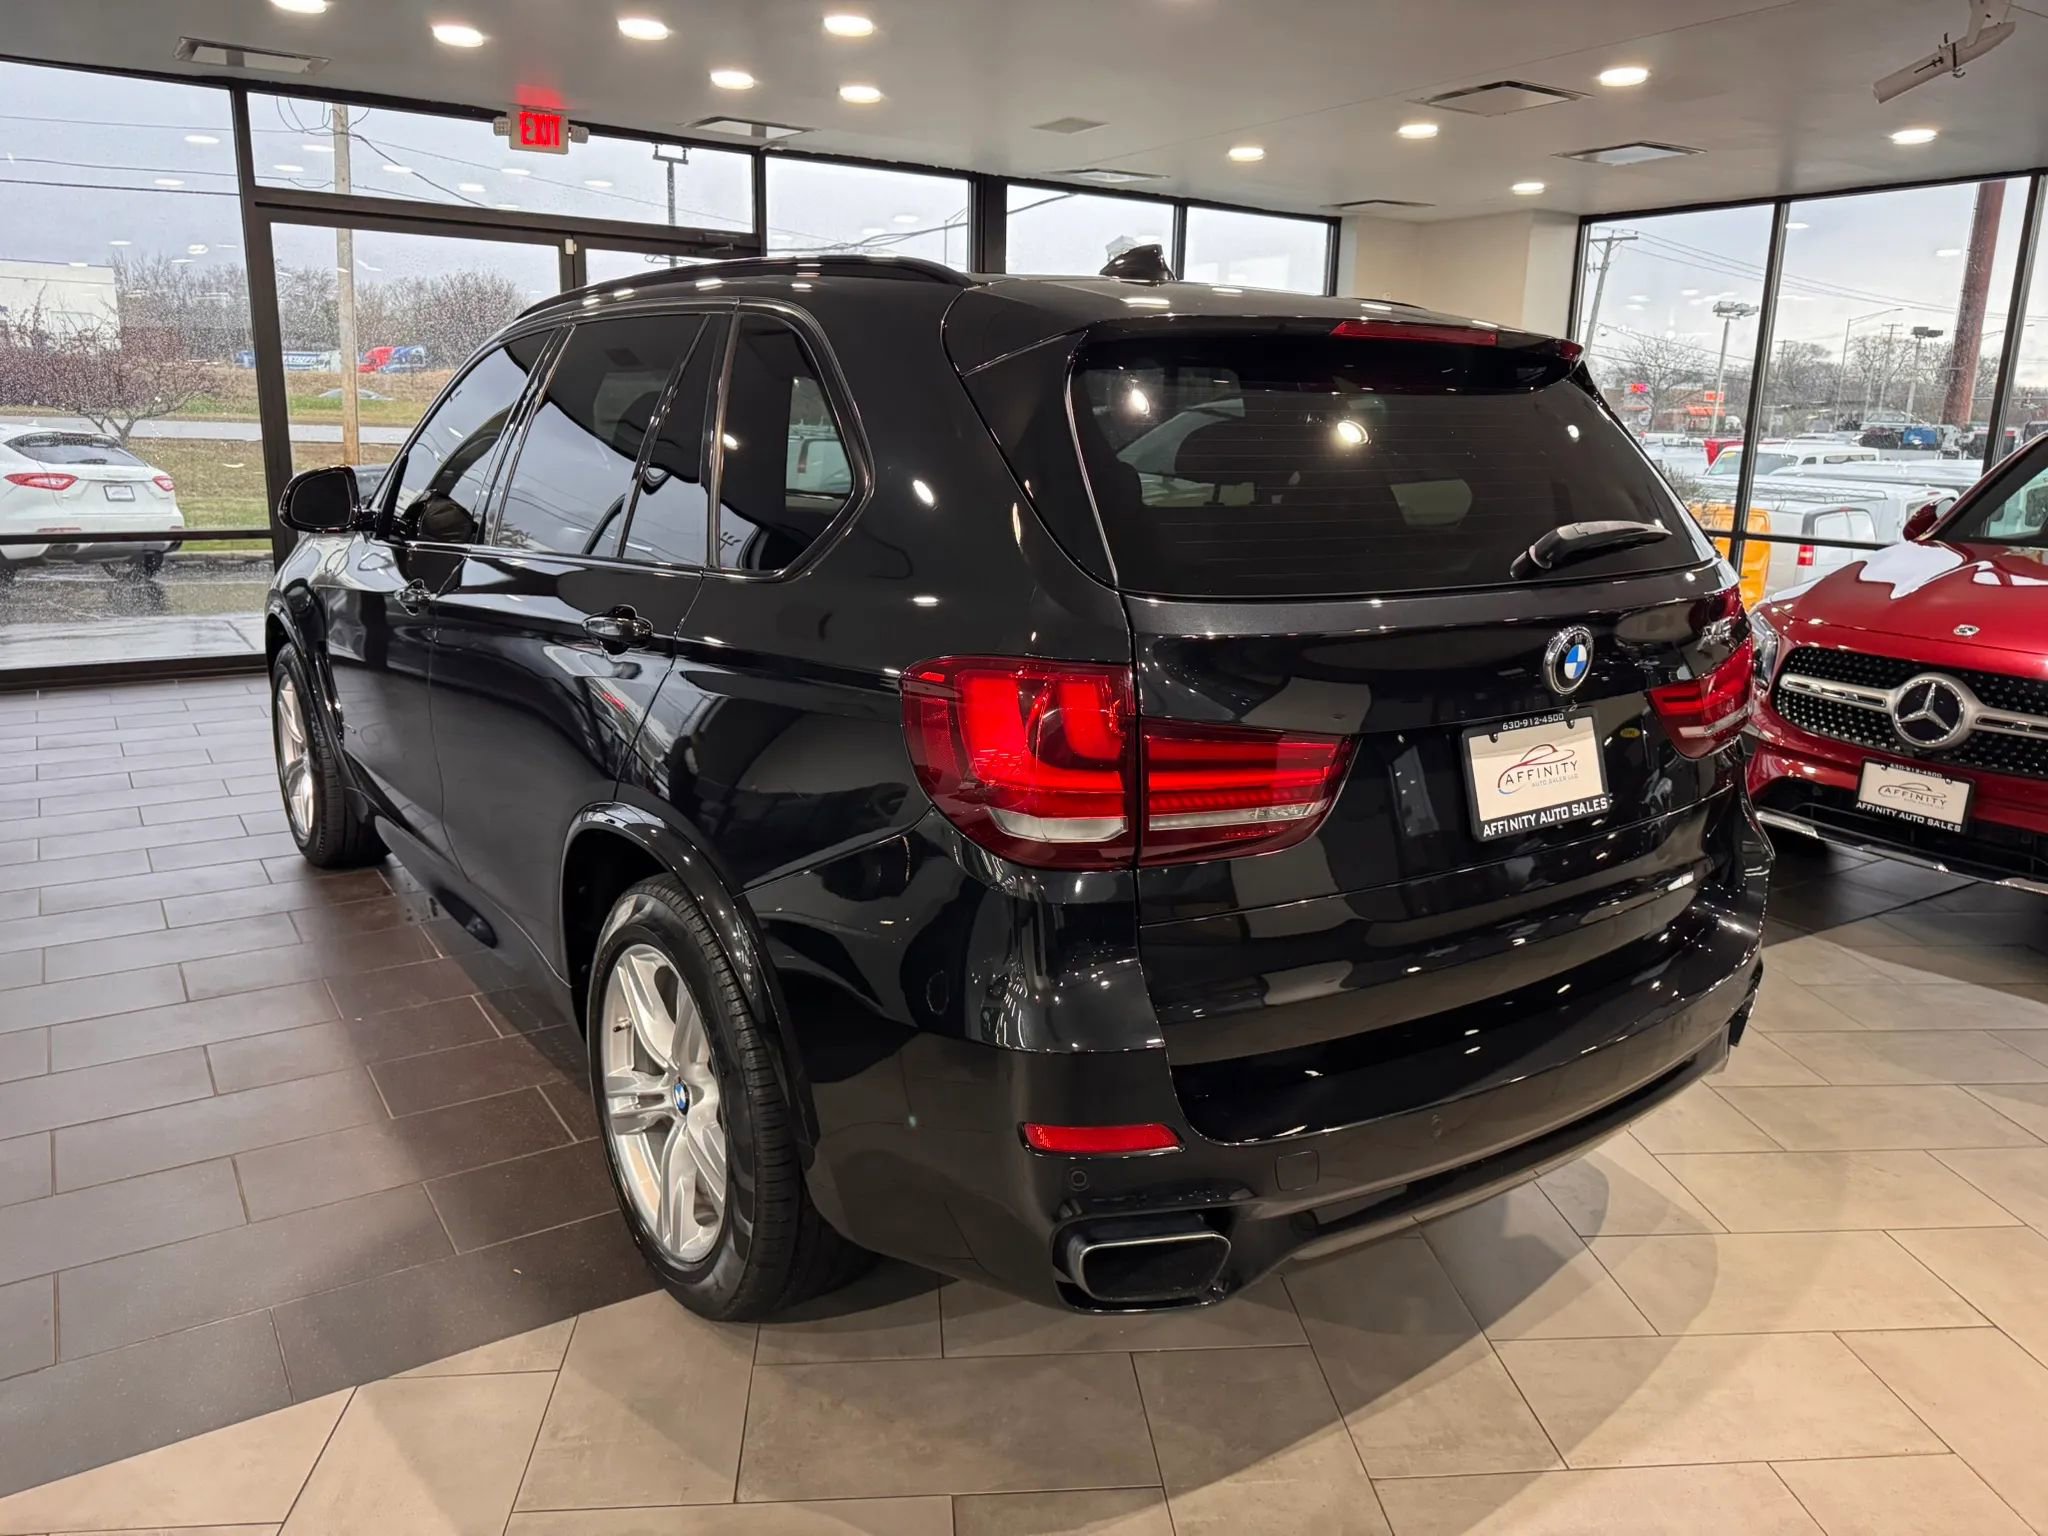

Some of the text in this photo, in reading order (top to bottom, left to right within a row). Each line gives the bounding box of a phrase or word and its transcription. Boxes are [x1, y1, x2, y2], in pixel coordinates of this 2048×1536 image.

[519, 111, 561, 147] EXIT
[1502, 713, 1564, 731] 630-912-4500
[1505, 760, 1578, 786] AFFINITY
[1884, 787, 1948, 806] AFFINITY
[1483, 797, 1608, 838] AFFINITY AUTO SALES
[1856, 802, 1897, 818] AFFINITY
[1899, 812, 1925, 824] AUTO
[1927, 818, 1961, 833] SALES
